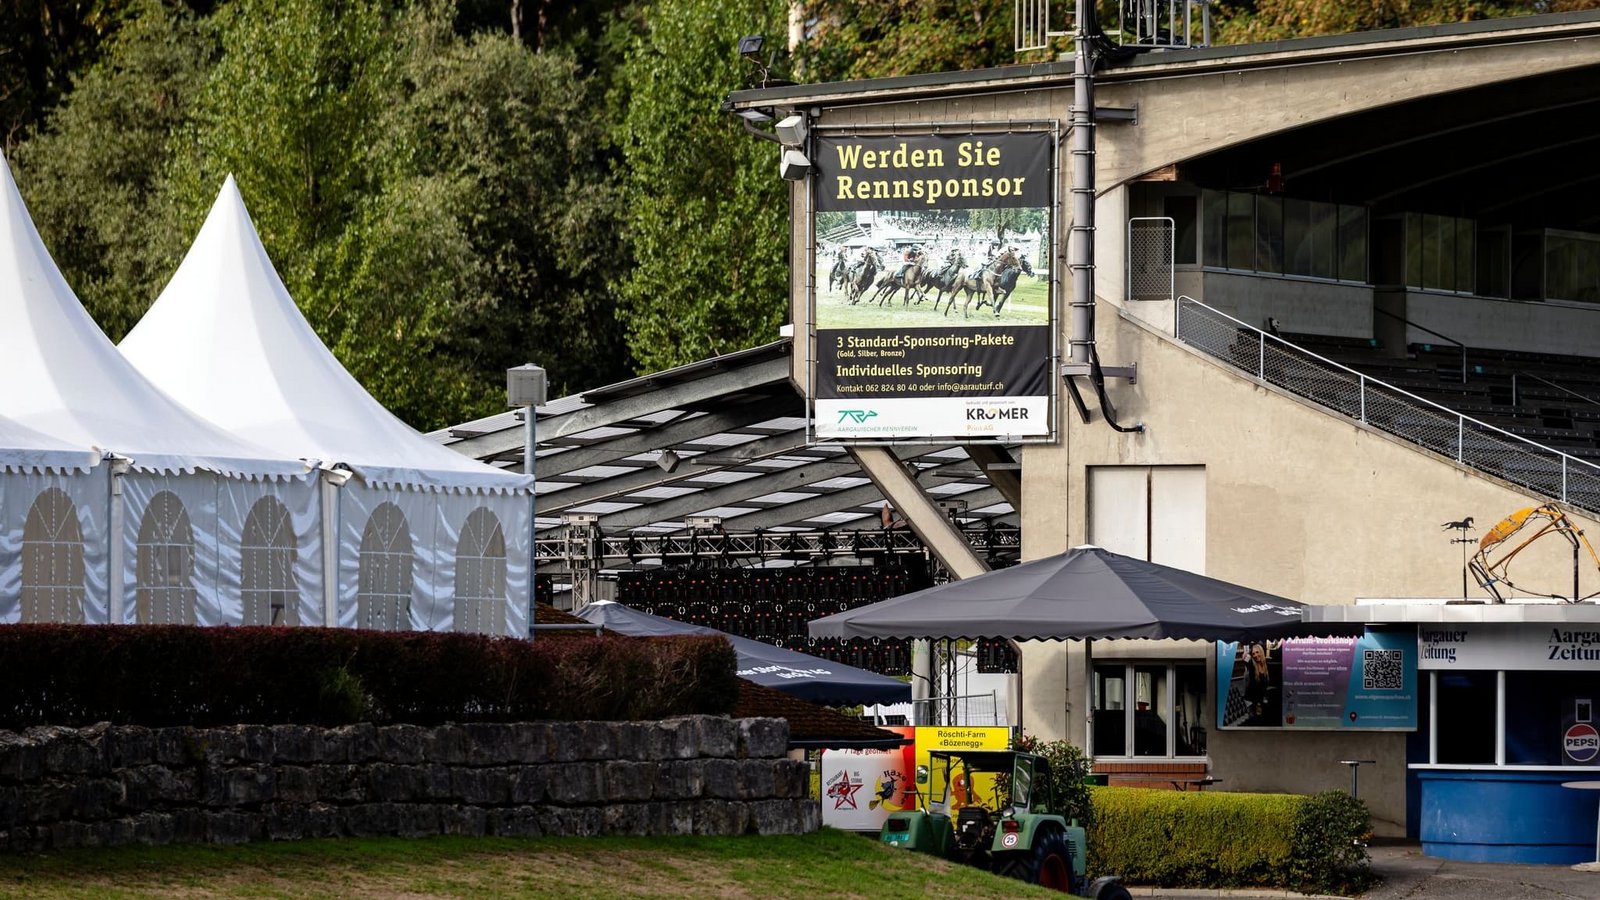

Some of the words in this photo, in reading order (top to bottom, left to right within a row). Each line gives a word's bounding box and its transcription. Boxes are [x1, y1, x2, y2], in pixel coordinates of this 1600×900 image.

[836, 143, 945, 170] Werden
[957, 141, 1001, 167] Sie
[836, 176, 1026, 204] Rennsponsor
[836, 336, 844, 348] 3
[847, 334, 1015, 349] Standard-Sponsoring-Pakete
[836, 350, 856, 359] (Gold,
[857, 350, 879, 358] Silber,
[880, 349, 906, 358] Bronze)
[836, 364, 913, 377] Individuelles
[916, 363, 983, 378] Sponsoring
[836, 384, 864, 393] Kontakt
[865, 384, 879, 392] 062
[880, 384, 895, 392] 824
[896, 384, 906, 392] 80
[907, 383, 918, 392] 40
[919, 383, 936, 392] oder
[937, 382, 1004, 392] info@aarauturf.ch
[937, 730, 986, 738] Röschti-Farm
[1566, 738, 1598, 747] PEPSI
[1005, 836, 1015, 844] 25
